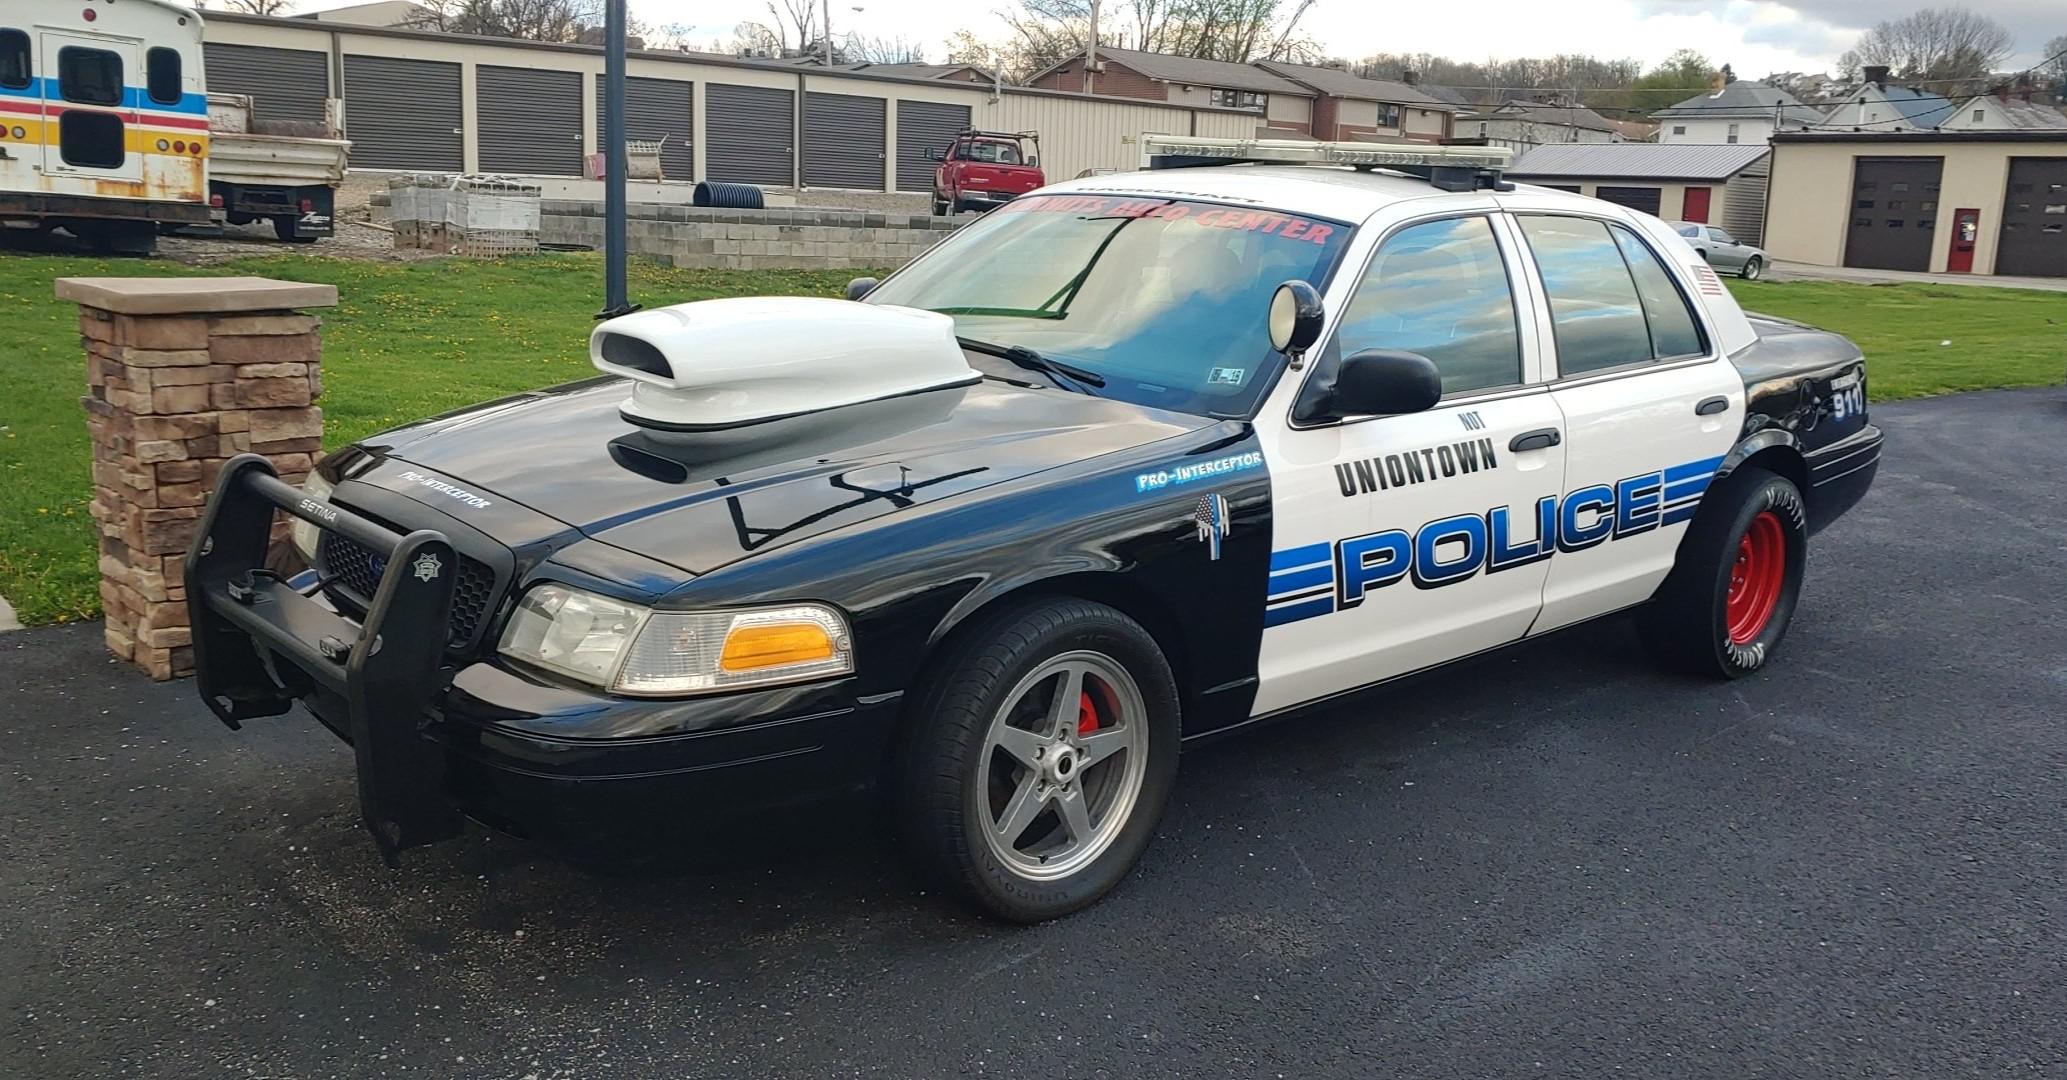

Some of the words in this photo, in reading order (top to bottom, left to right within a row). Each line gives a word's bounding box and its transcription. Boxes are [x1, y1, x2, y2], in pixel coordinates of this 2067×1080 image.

[1196, 209, 1334, 245] CENTER
[1457, 411, 1487, 431] NOT
[1136, 452, 1262, 491] PRO-INTERCEPTOR
[1334, 437, 1498, 498] UNIONTOWN
[299, 498, 337, 523] SETINA
[1335, 470, 1662, 613] POLICE
